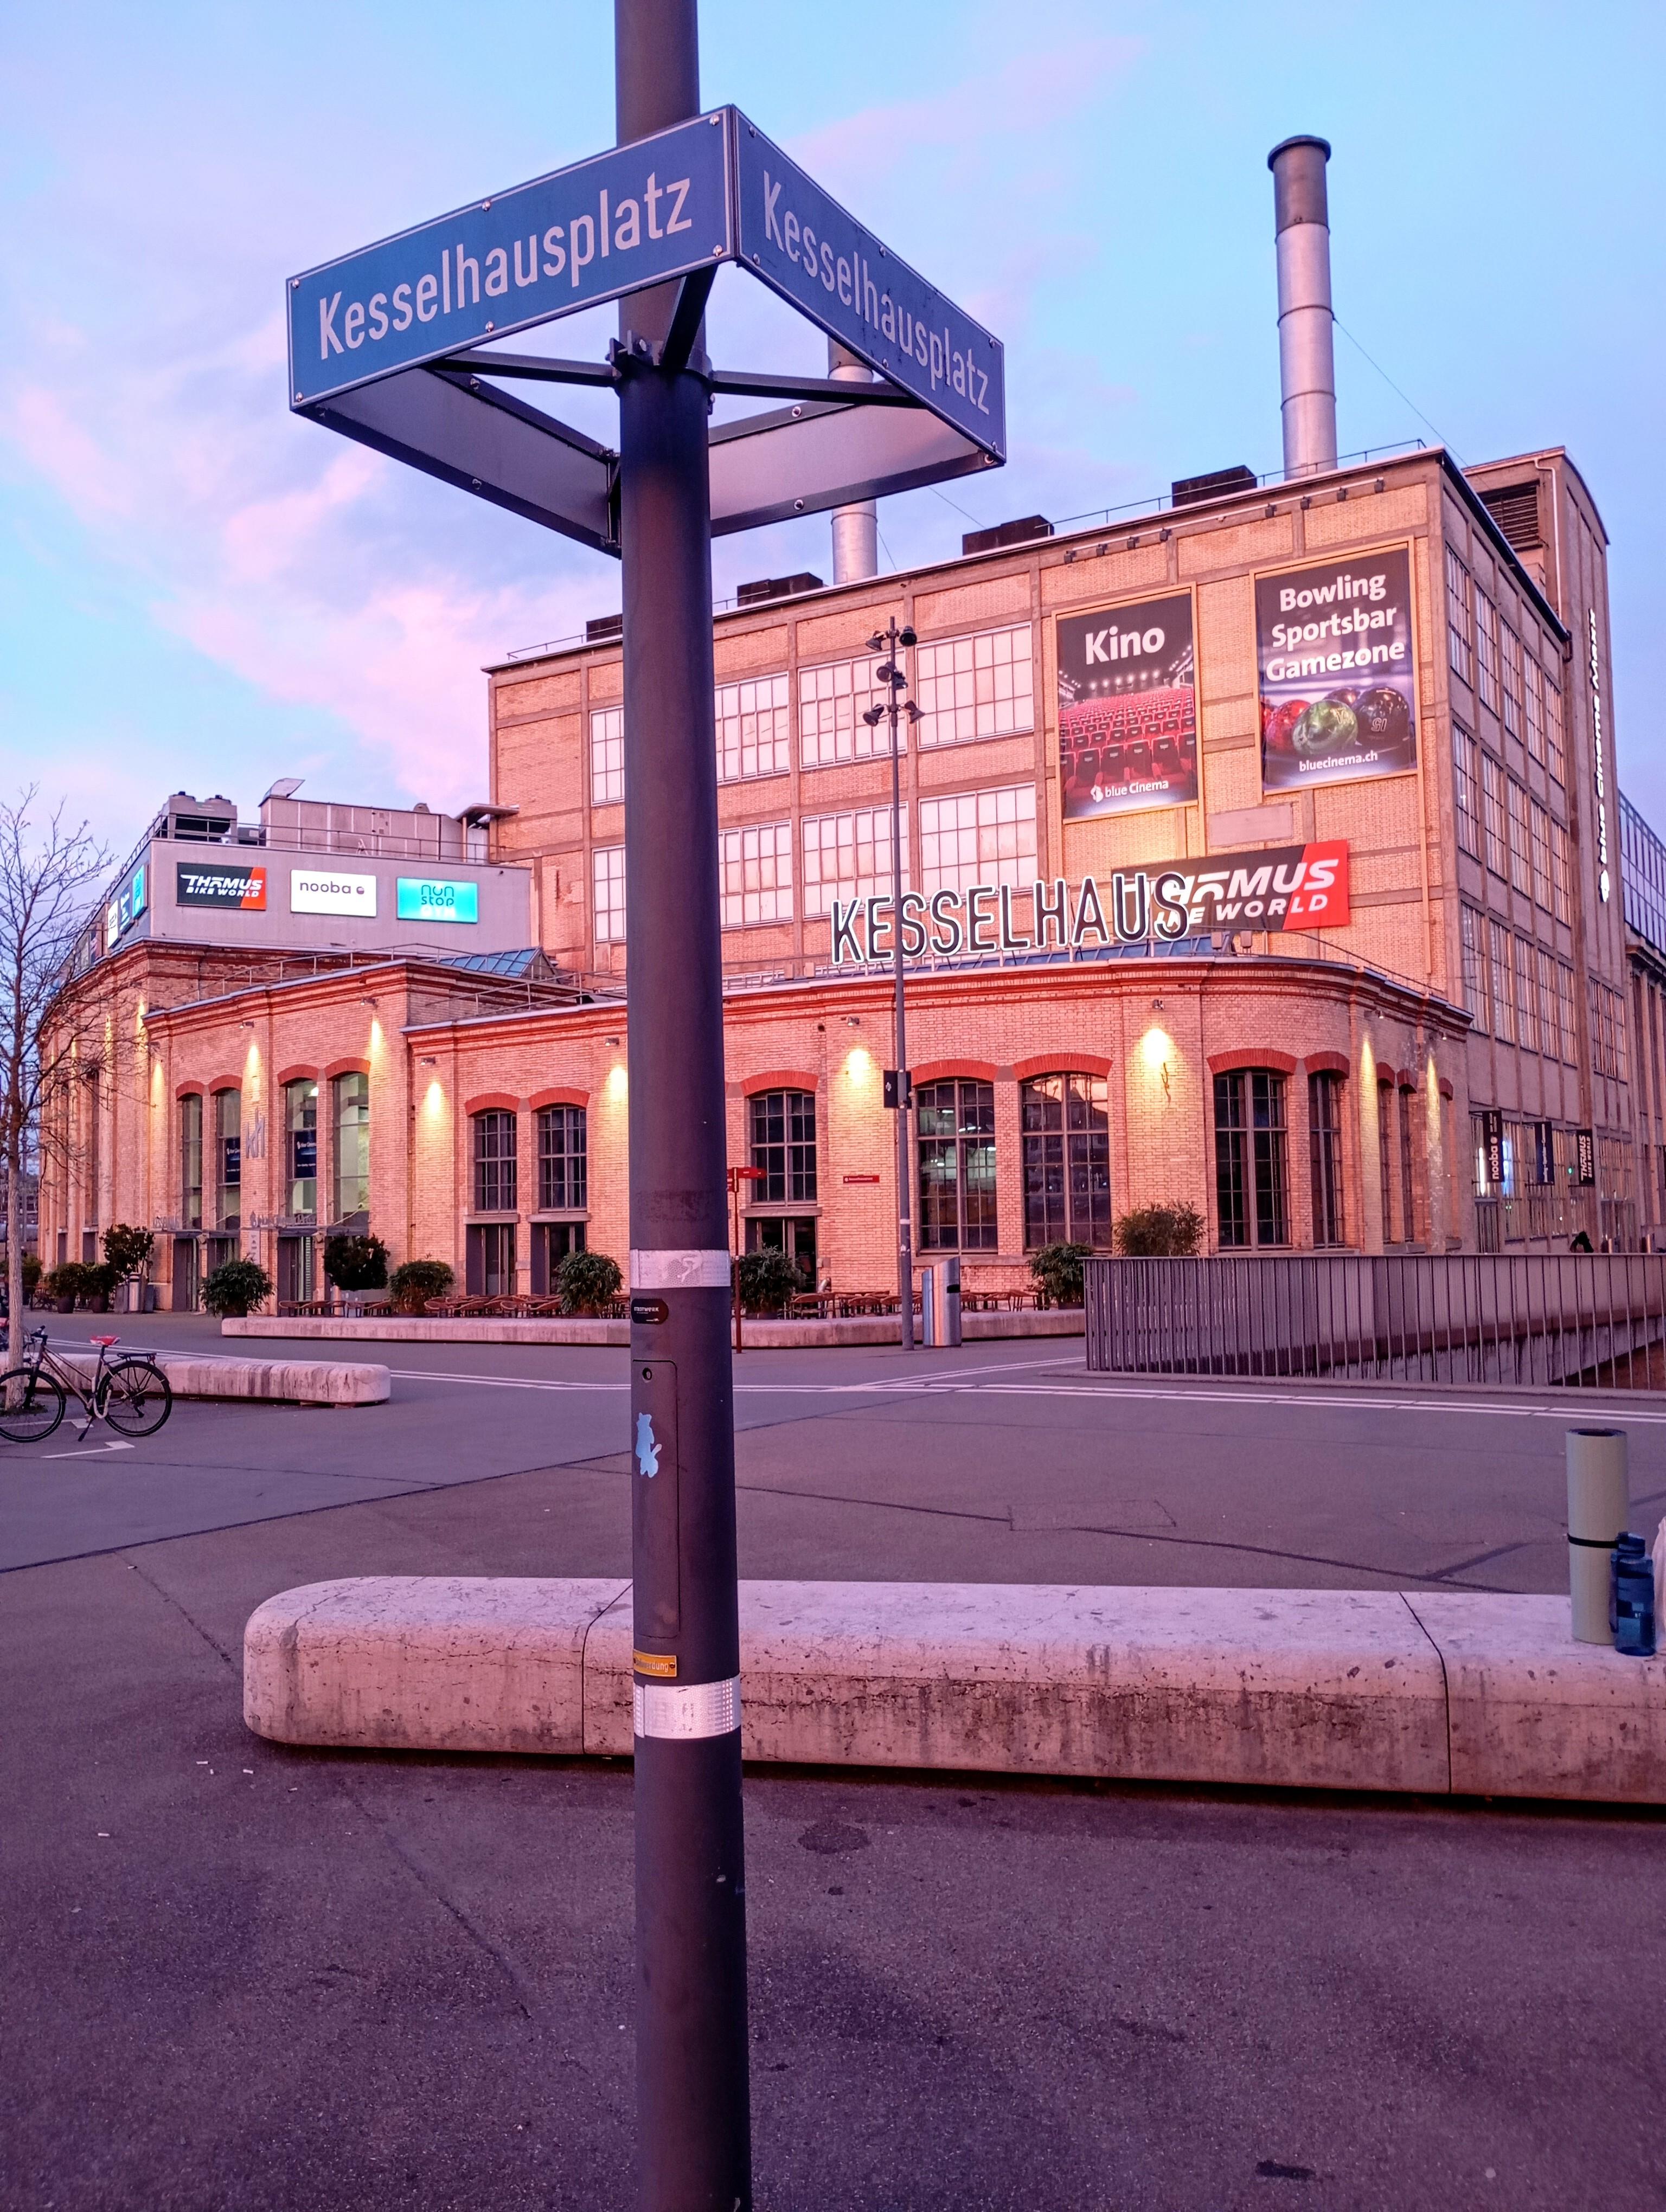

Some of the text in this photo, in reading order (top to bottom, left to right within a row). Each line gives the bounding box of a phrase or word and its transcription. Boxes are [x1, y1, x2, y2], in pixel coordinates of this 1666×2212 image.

[319, 172, 693, 360] Kesselhausplatz
[764, 170, 990, 415] Kesselhausplatz
[1280, 575, 1386, 612] Bowling
[1085, 625, 1165, 665] Kino
[1272, 607, 1397, 652] Sportsbar
[1266, 642, 1405, 681] Gamezone
[1299, 750, 1378, 772] bluecinema.ch
[1105, 780, 1169, 799] blue Cinema
[186, 886, 259, 897] BIKE WORLD
[300, 881, 351, 894] nooba
[421, 896, 454, 906] stop
[831, 872, 1190, 964] KESSELHAUS
[1216, 895, 1328, 921] WORLD
[1489, 1145, 1499, 1180] nooba
